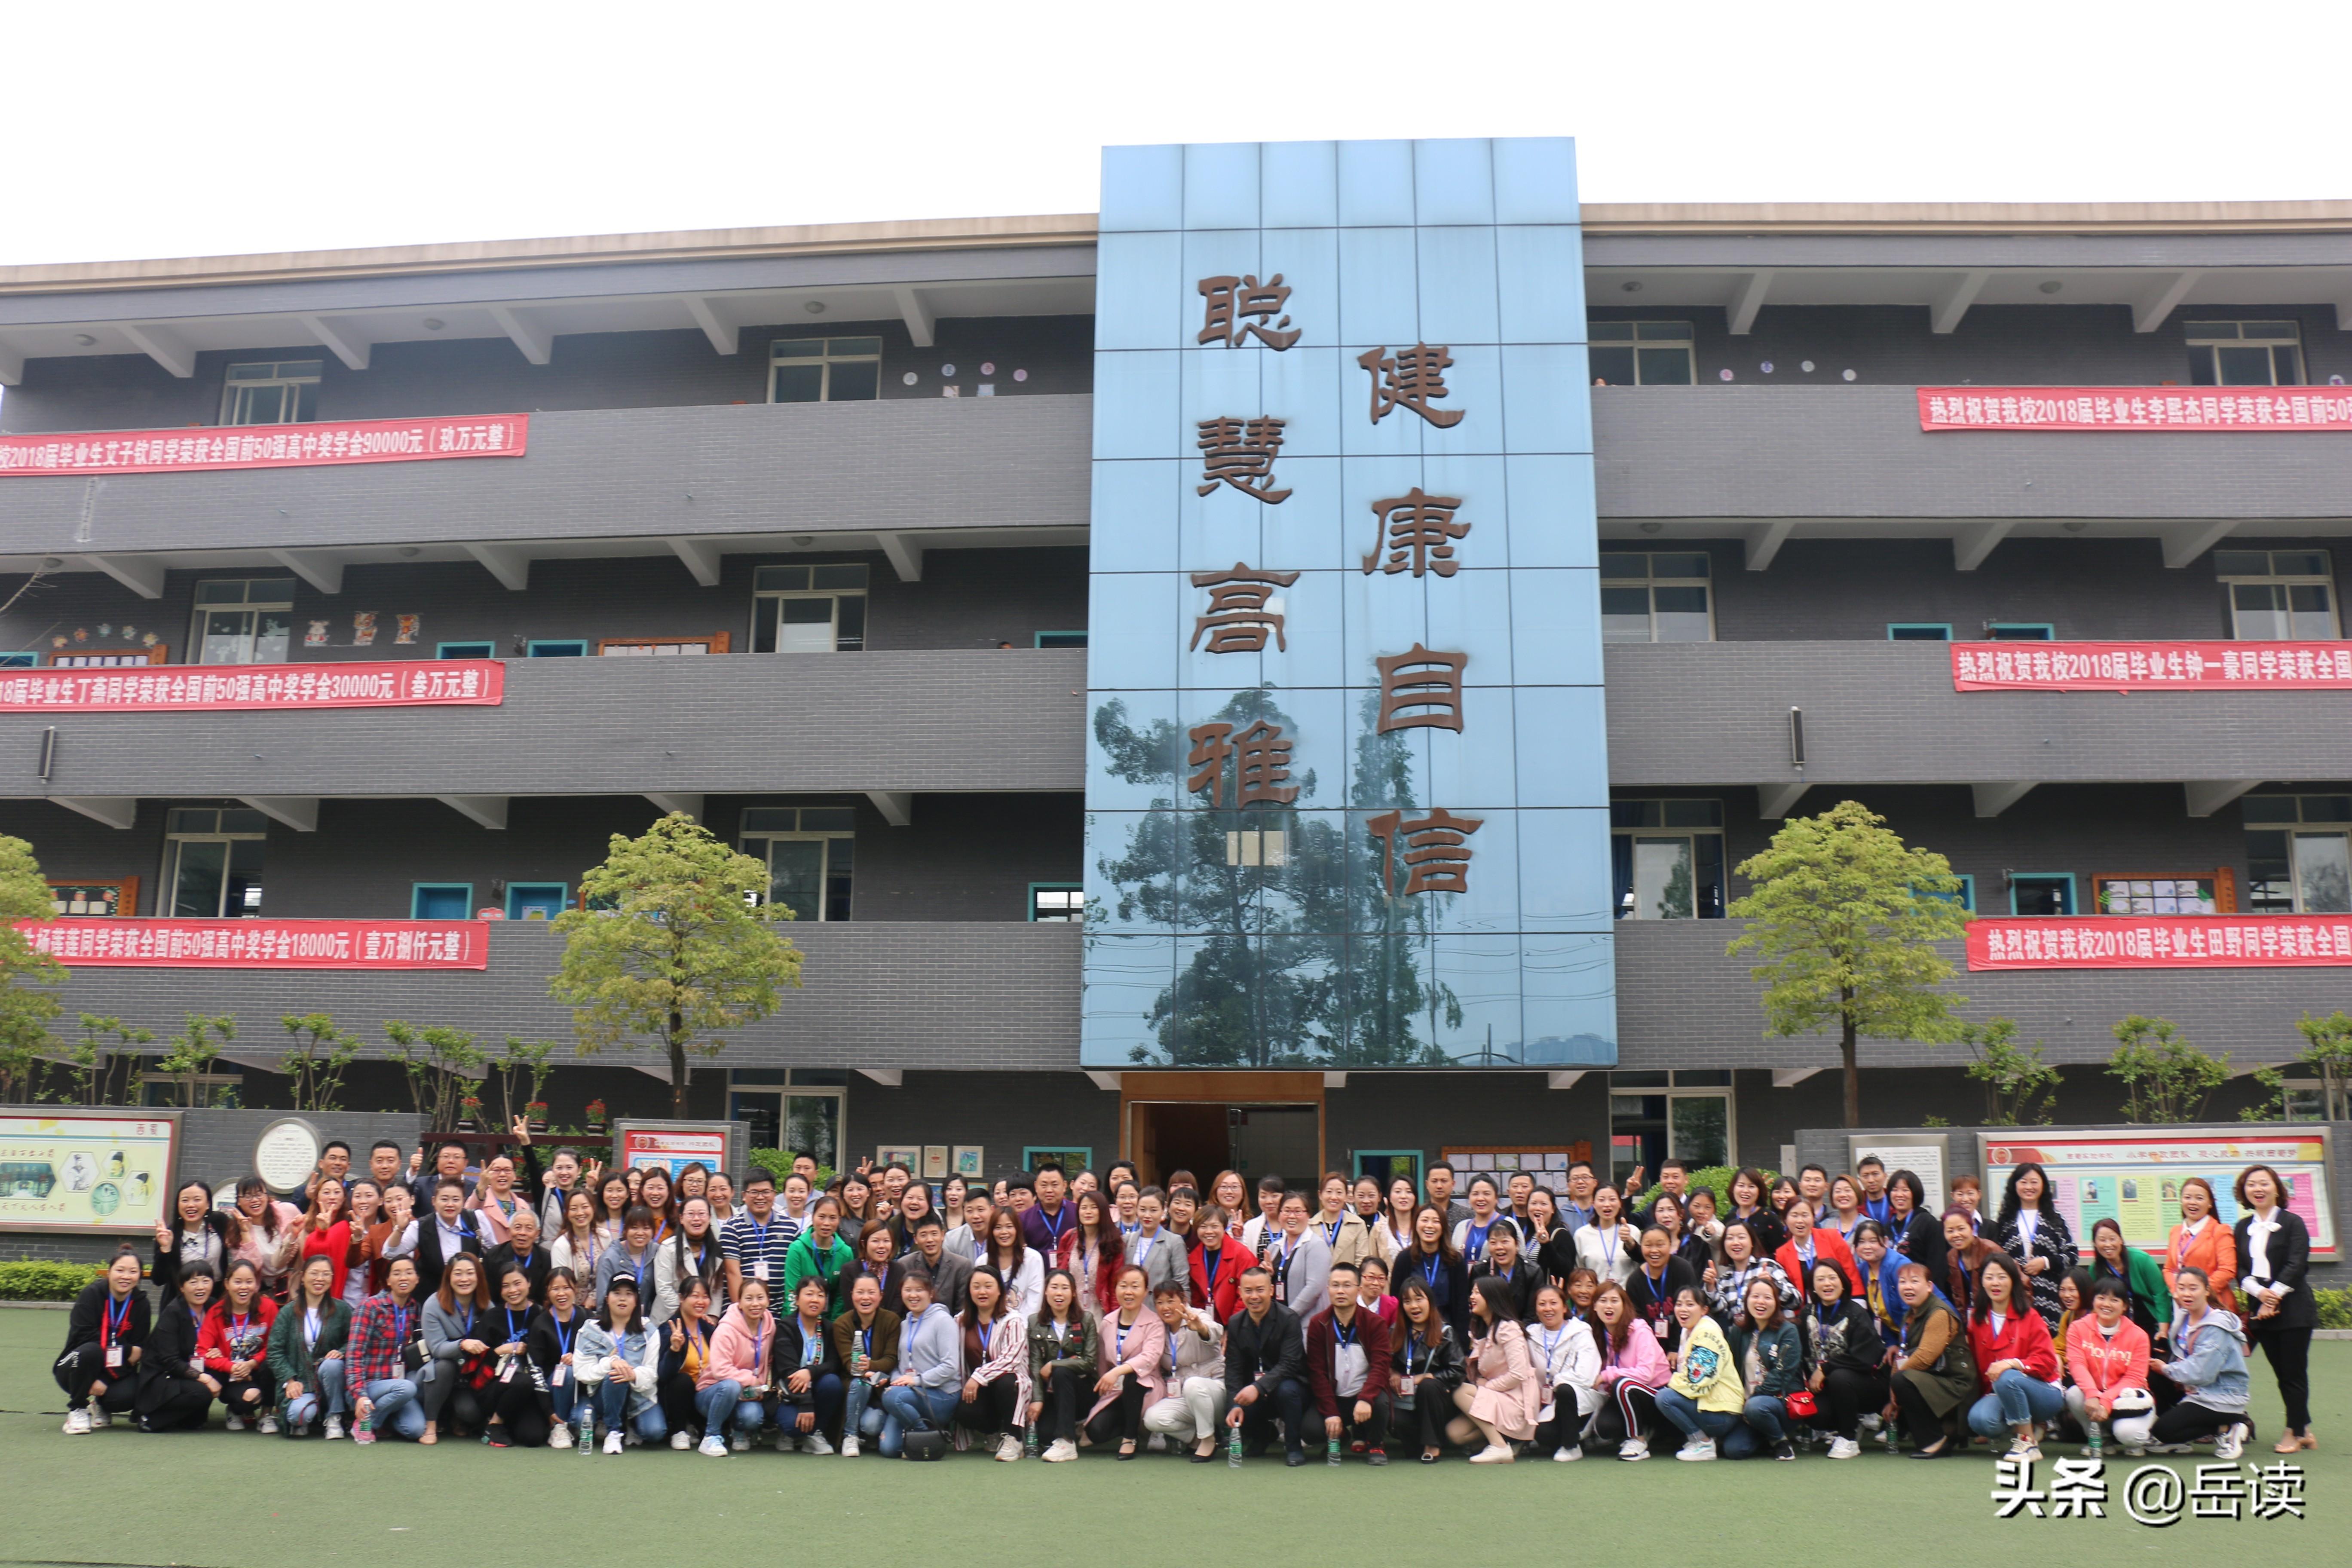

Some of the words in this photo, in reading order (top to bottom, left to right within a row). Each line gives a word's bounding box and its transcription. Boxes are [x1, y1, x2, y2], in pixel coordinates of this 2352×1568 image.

[1188, 273, 1302, 808] 聪慧高雅
[1357, 340, 1485, 896] 健康自信
